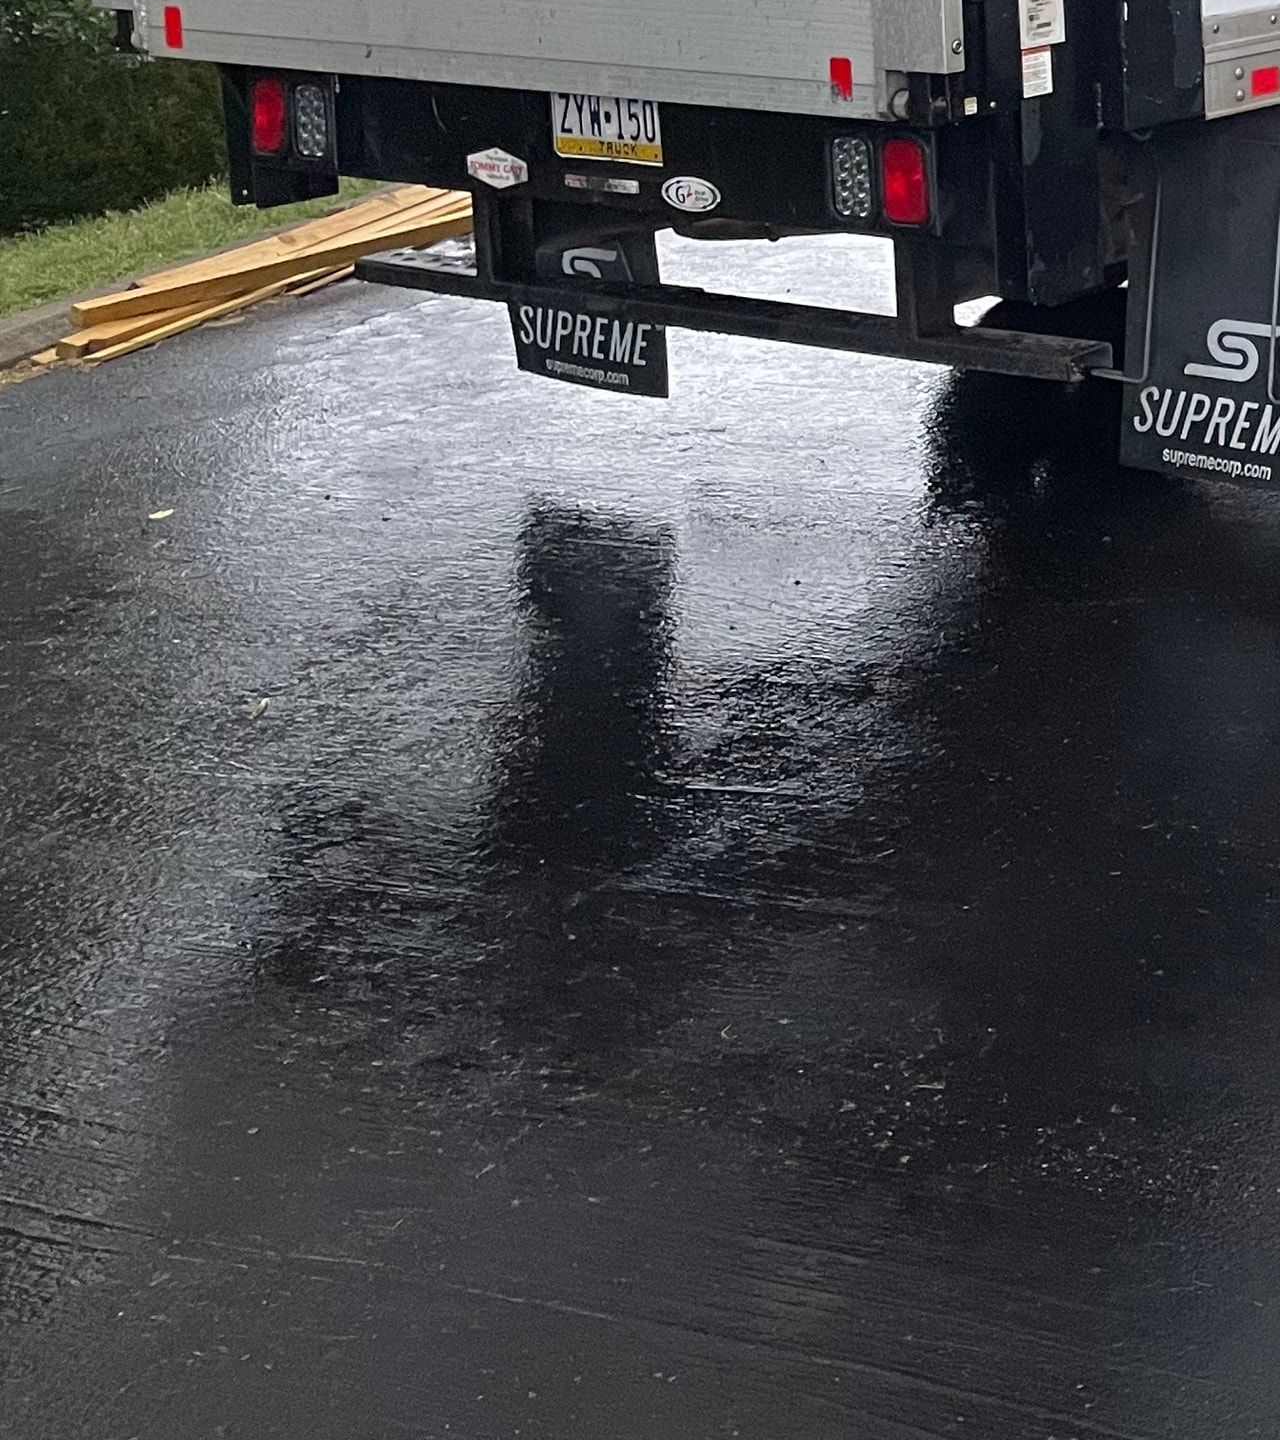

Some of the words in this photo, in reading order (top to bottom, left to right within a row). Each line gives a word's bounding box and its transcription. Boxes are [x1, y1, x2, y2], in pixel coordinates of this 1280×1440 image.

[599, 141, 637, 157] TRUCK
[520, 305, 652, 366] SUPREME
[1162, 448, 1272, 481] supremecorp.com
